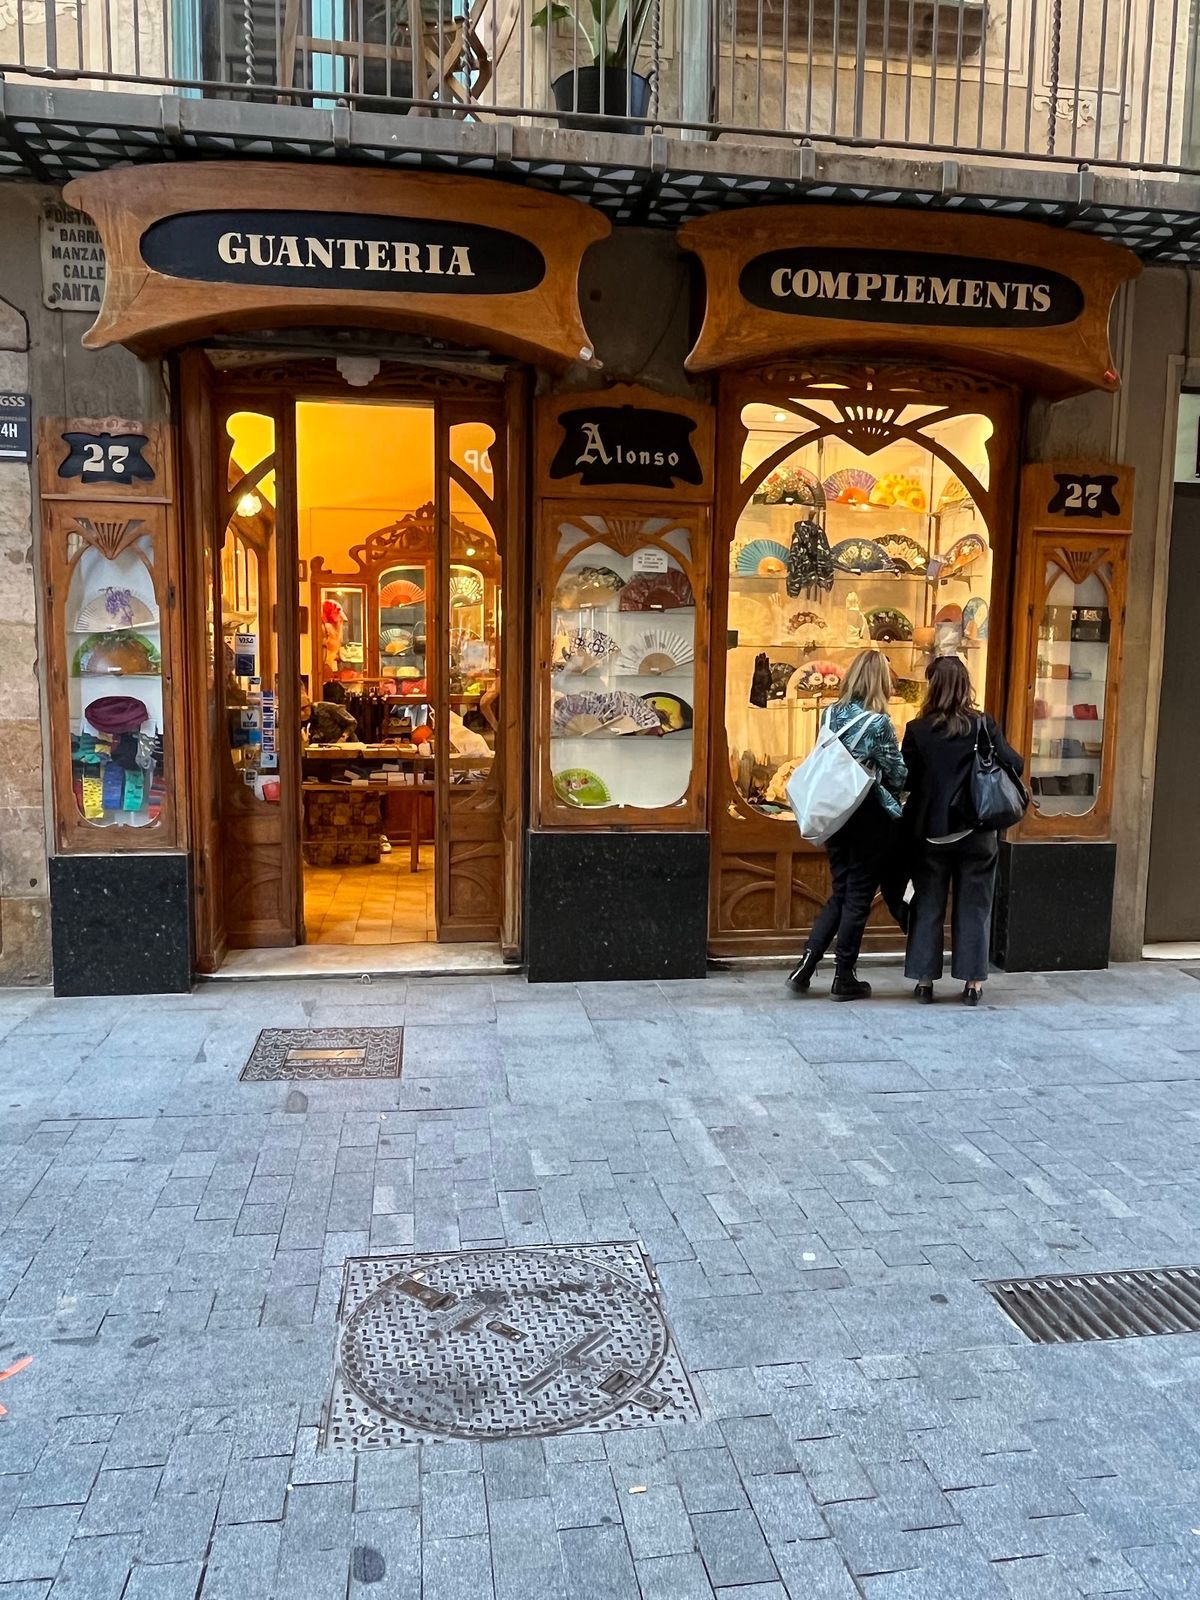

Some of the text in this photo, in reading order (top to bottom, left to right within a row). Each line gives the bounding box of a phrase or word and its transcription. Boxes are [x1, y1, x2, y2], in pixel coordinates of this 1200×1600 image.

[217, 232, 475, 276] GUANTERIA
[63, 264, 105, 280] CALLE
[52, 282, 101, 302] SANTA
[770, 268, 1052, 312] COMPLEMENTS
[0, 395, 26, 407] GSS
[0, 422, 18, 438] 4H
[575, 422, 680, 467] Alonso
[82, 443, 130, 474] 27
[1065, 483, 1102, 509] 27
